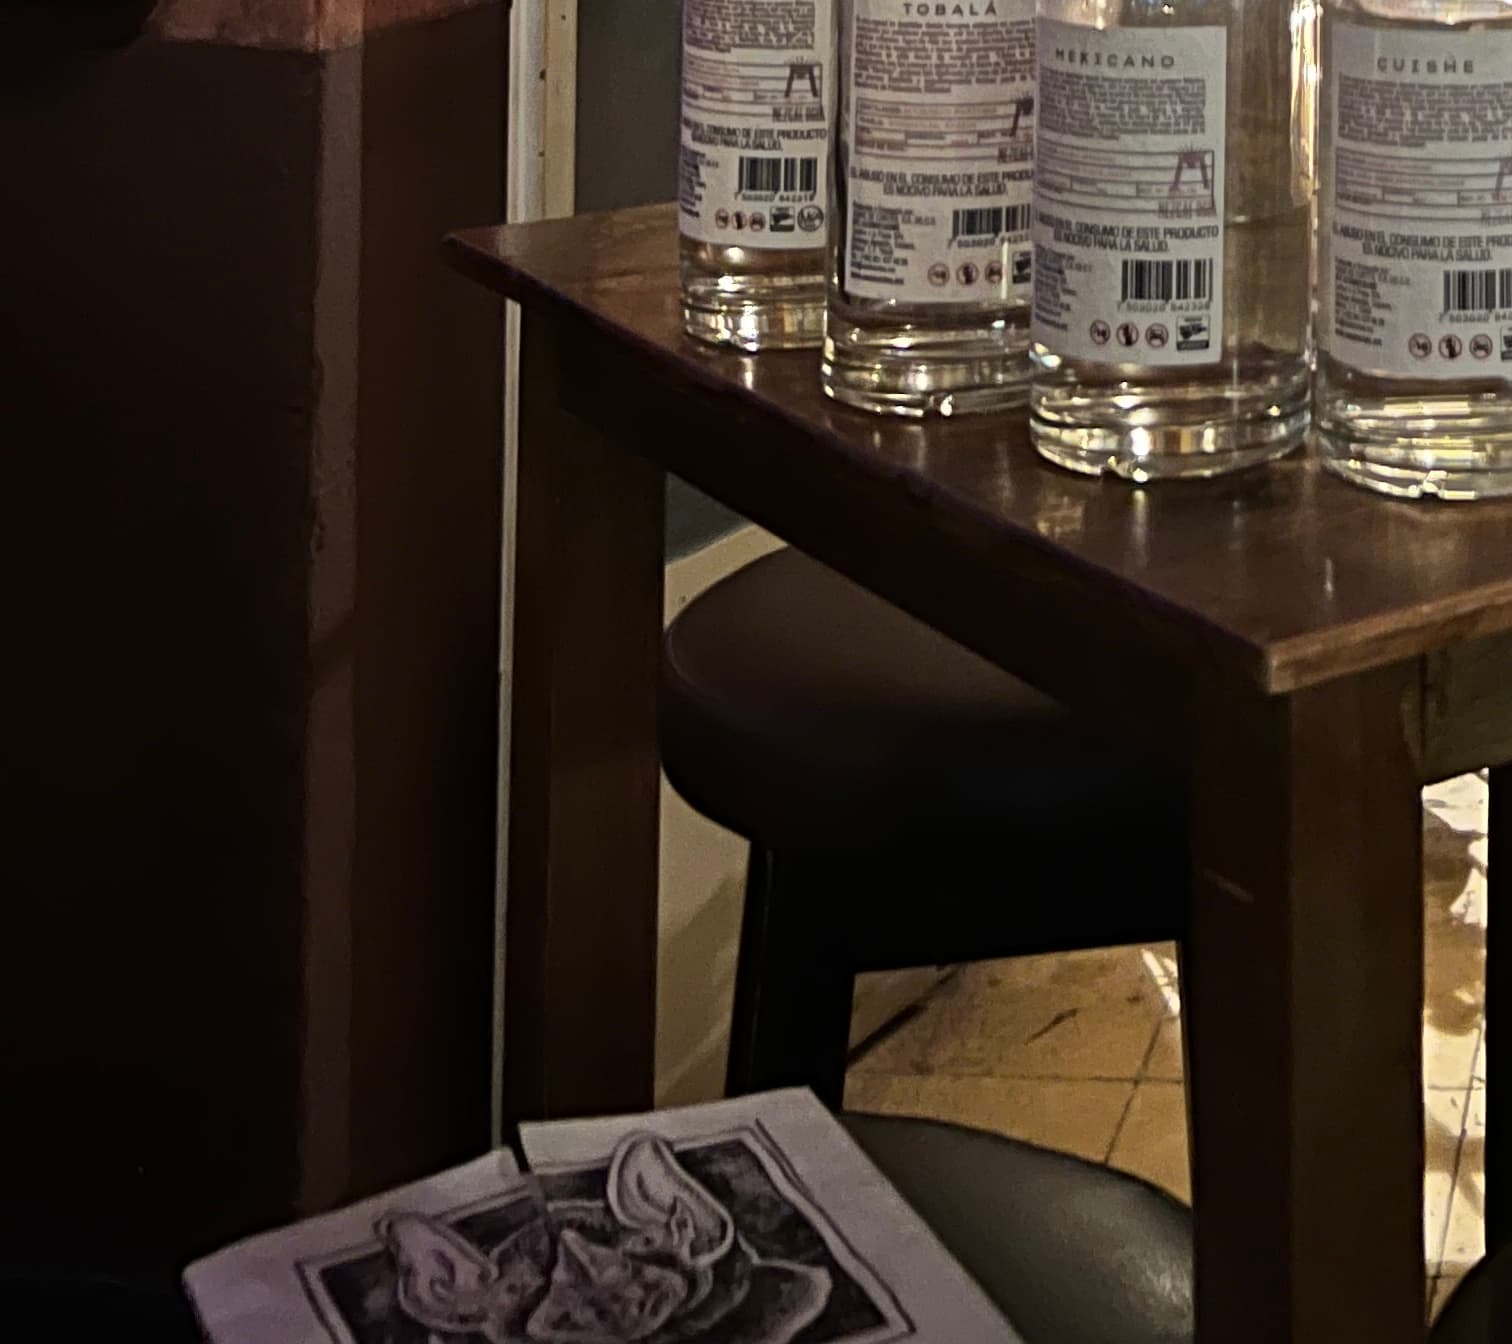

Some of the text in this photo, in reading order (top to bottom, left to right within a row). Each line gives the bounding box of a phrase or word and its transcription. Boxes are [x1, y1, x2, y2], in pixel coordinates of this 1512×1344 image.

[903, 0, 997, 17] TOBALÁ
[1055, 47, 1175, 68] MEXICANO
[1376, 57, 1474, 74] CUISHE
